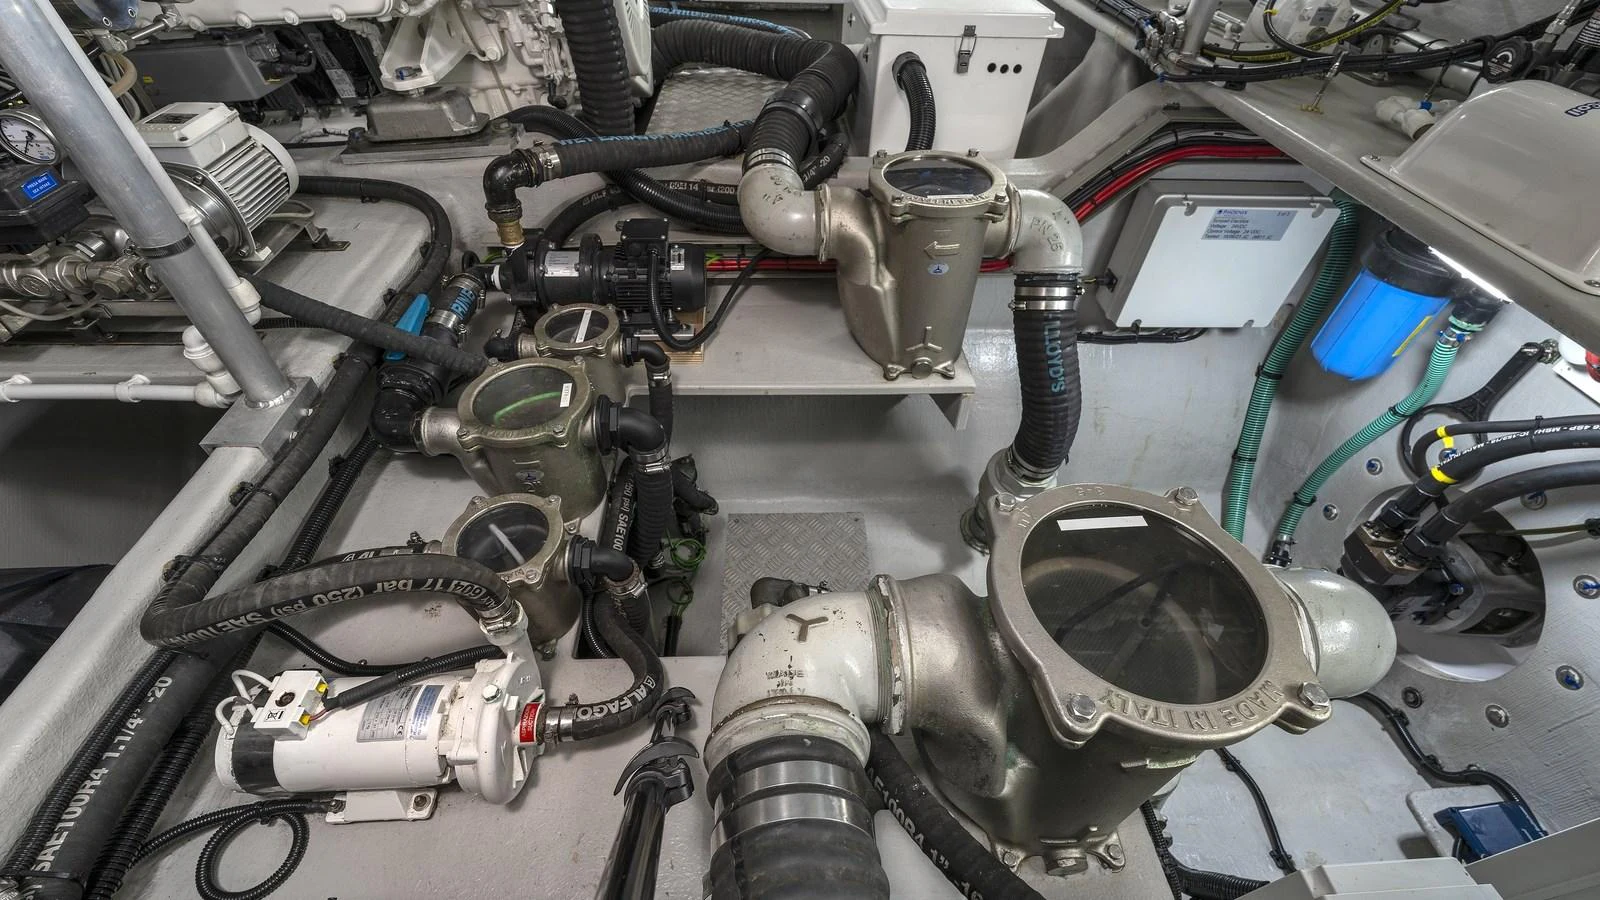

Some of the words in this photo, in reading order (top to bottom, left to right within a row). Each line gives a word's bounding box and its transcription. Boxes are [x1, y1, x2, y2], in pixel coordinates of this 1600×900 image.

[373, 578, 413, 595] bar
[423, 577, 447, 592] 17
[1099, 687, 1179, 730] ITALY
[1220, 679, 1286, 729] MADE
[1183, 710, 1218, 732] IN
